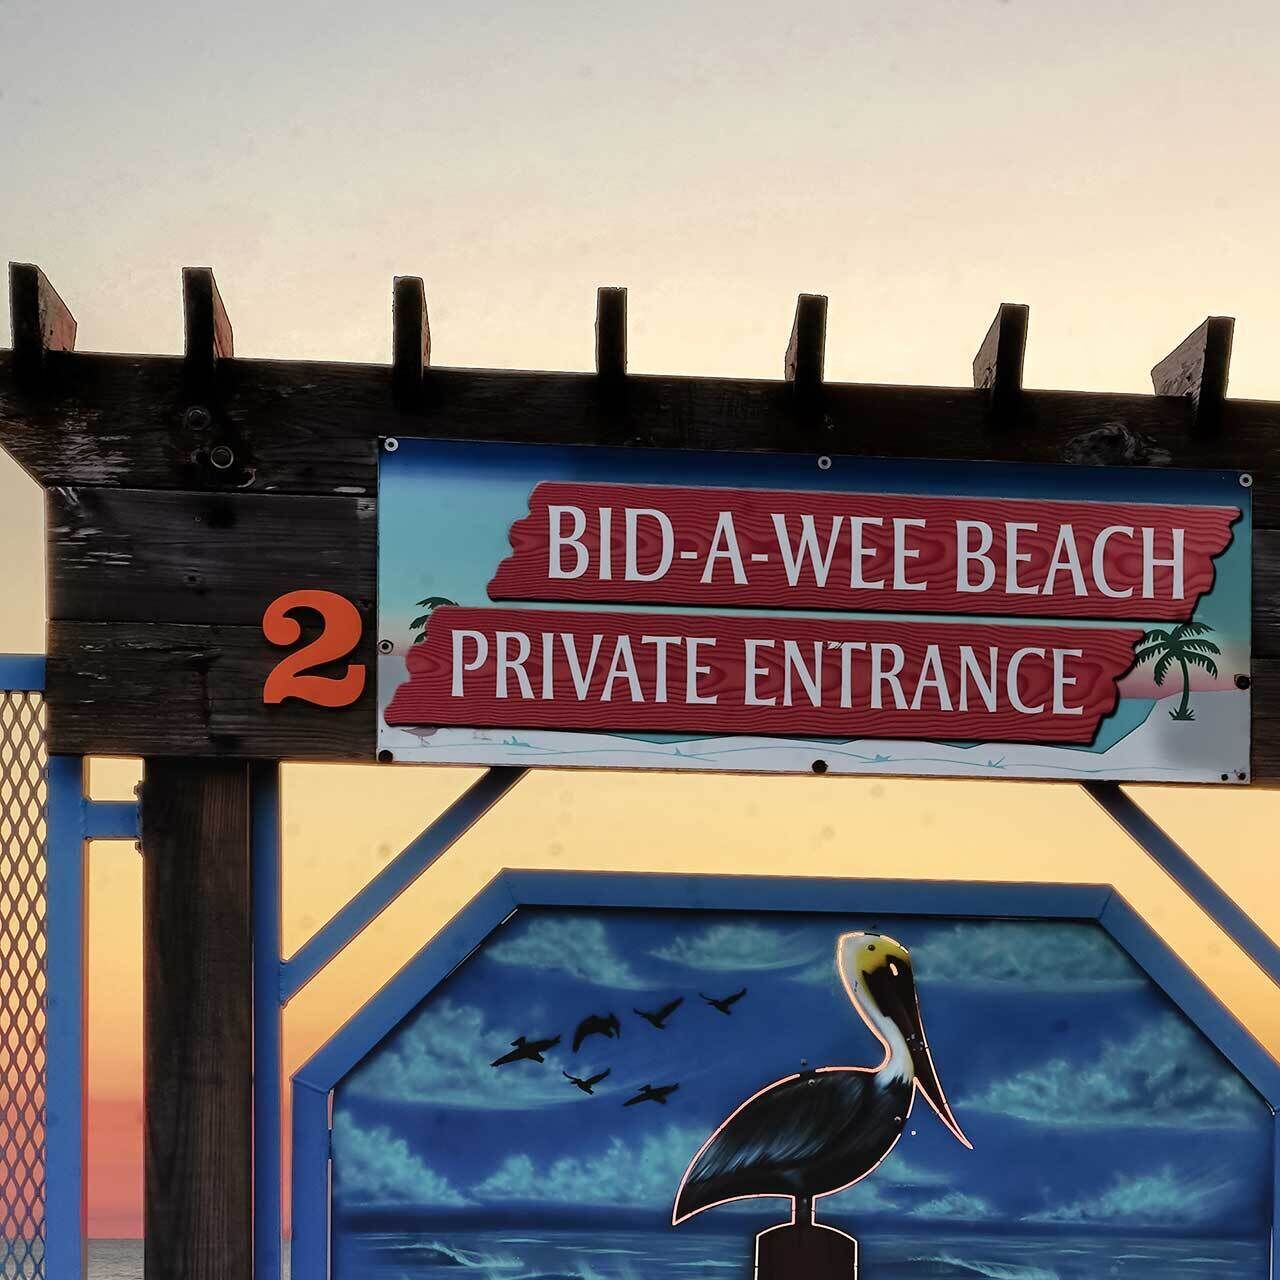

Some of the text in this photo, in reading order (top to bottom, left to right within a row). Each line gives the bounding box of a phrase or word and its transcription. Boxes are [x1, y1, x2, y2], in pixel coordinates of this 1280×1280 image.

[548, 505, 1185, 600] BID-A-WEE BEACH
[262, 589, 366, 708] 2
[451, 629, 1085, 716] PRIVATE ENTRANCE
